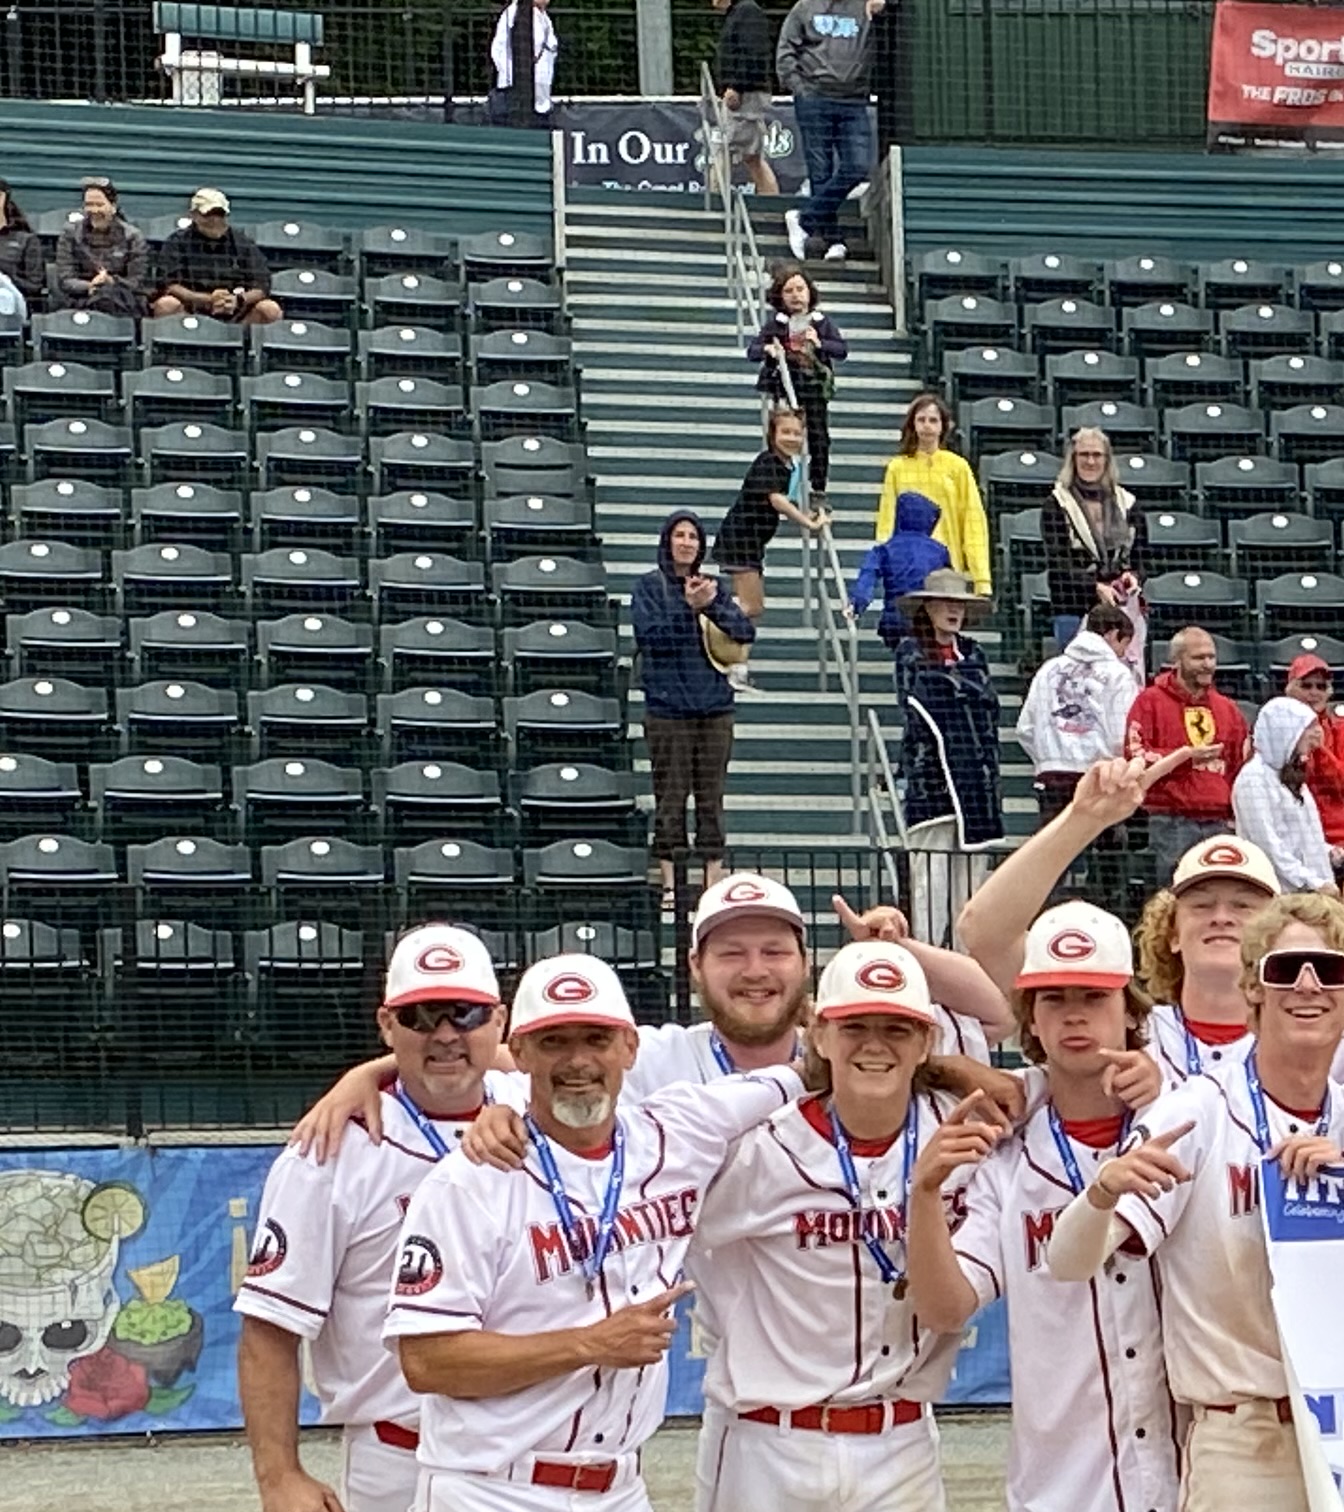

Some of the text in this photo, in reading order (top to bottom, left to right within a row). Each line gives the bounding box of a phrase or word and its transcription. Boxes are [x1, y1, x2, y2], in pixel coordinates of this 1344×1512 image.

[570, 130, 610, 165] In
[617, 129, 690, 165] Our
[1202, 844, 1245, 867] G
[722, 881, 766, 903] G
[418, 946, 460, 973] G
[1049, 933, 1094, 961] G
[856, 961, 903, 990] G
[546, 976, 593, 1003] G
